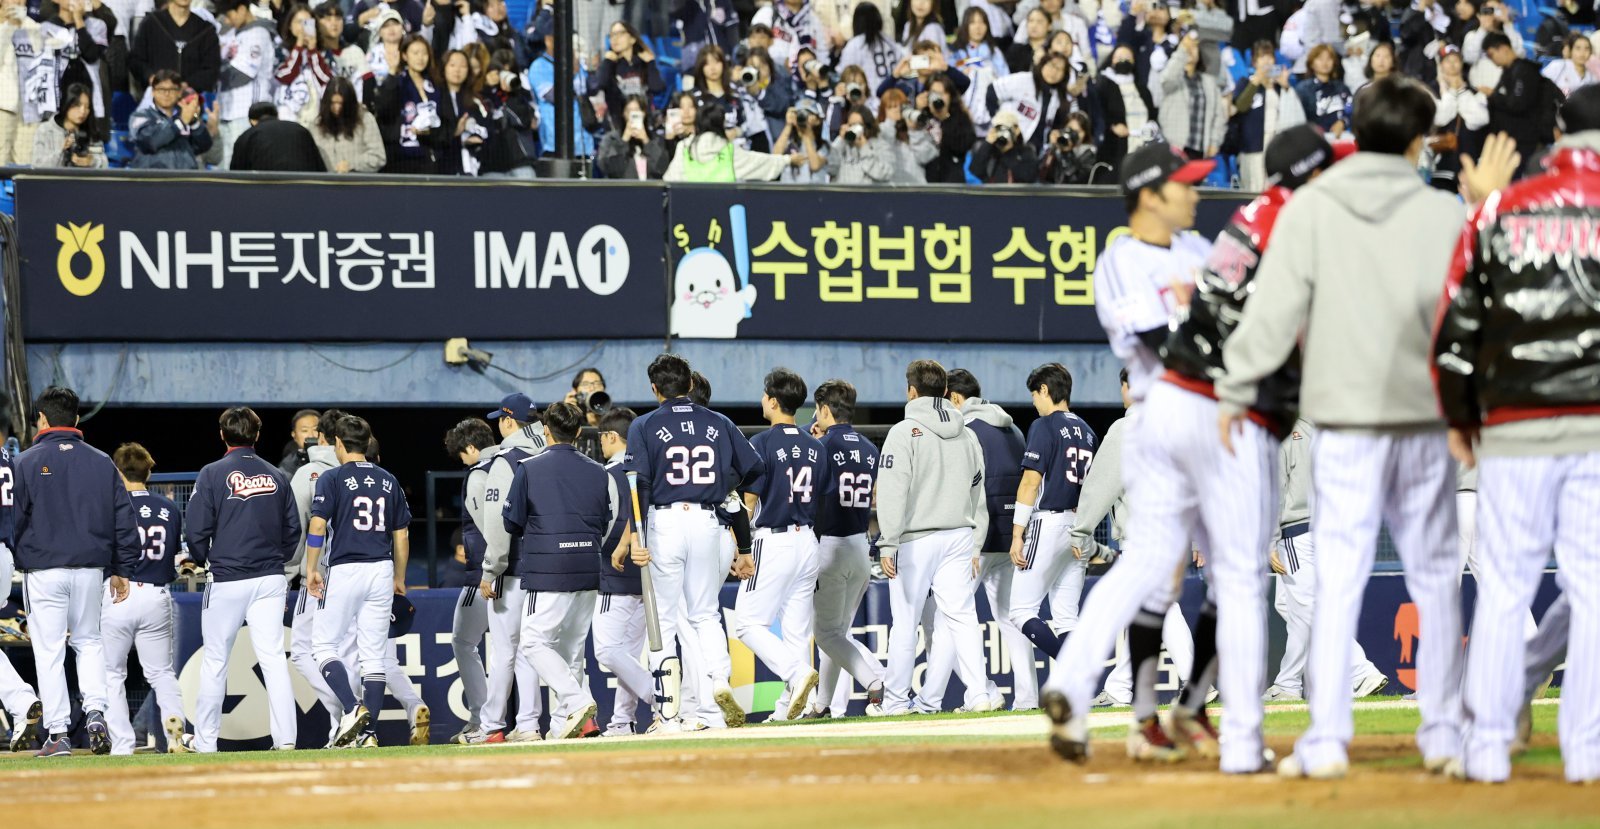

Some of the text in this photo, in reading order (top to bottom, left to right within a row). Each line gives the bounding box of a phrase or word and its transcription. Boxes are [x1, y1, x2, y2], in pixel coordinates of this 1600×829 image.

[1501, 215, 1600, 258] TWI
[119, 230, 436, 292] NH투자증권
[751, 221, 1131, 305] 수협보험 수협
[656, 420, 719, 443] 김대한
[665, 445, 716, 486] 32
[776, 445, 817, 463] 류승민
[879, 454, 894, 469] 16
[1066, 446, 1093, 485] 37
[229, 471, 277, 495] Bears
[344, 475, 393, 494] 정수빈
[485, 488, 500, 502] 28
[786, 465, 813, 504] 14
[839, 471, 873, 508] 62
[139, 505, 170, 521] 승호
[353, 496, 386, 532] 31
